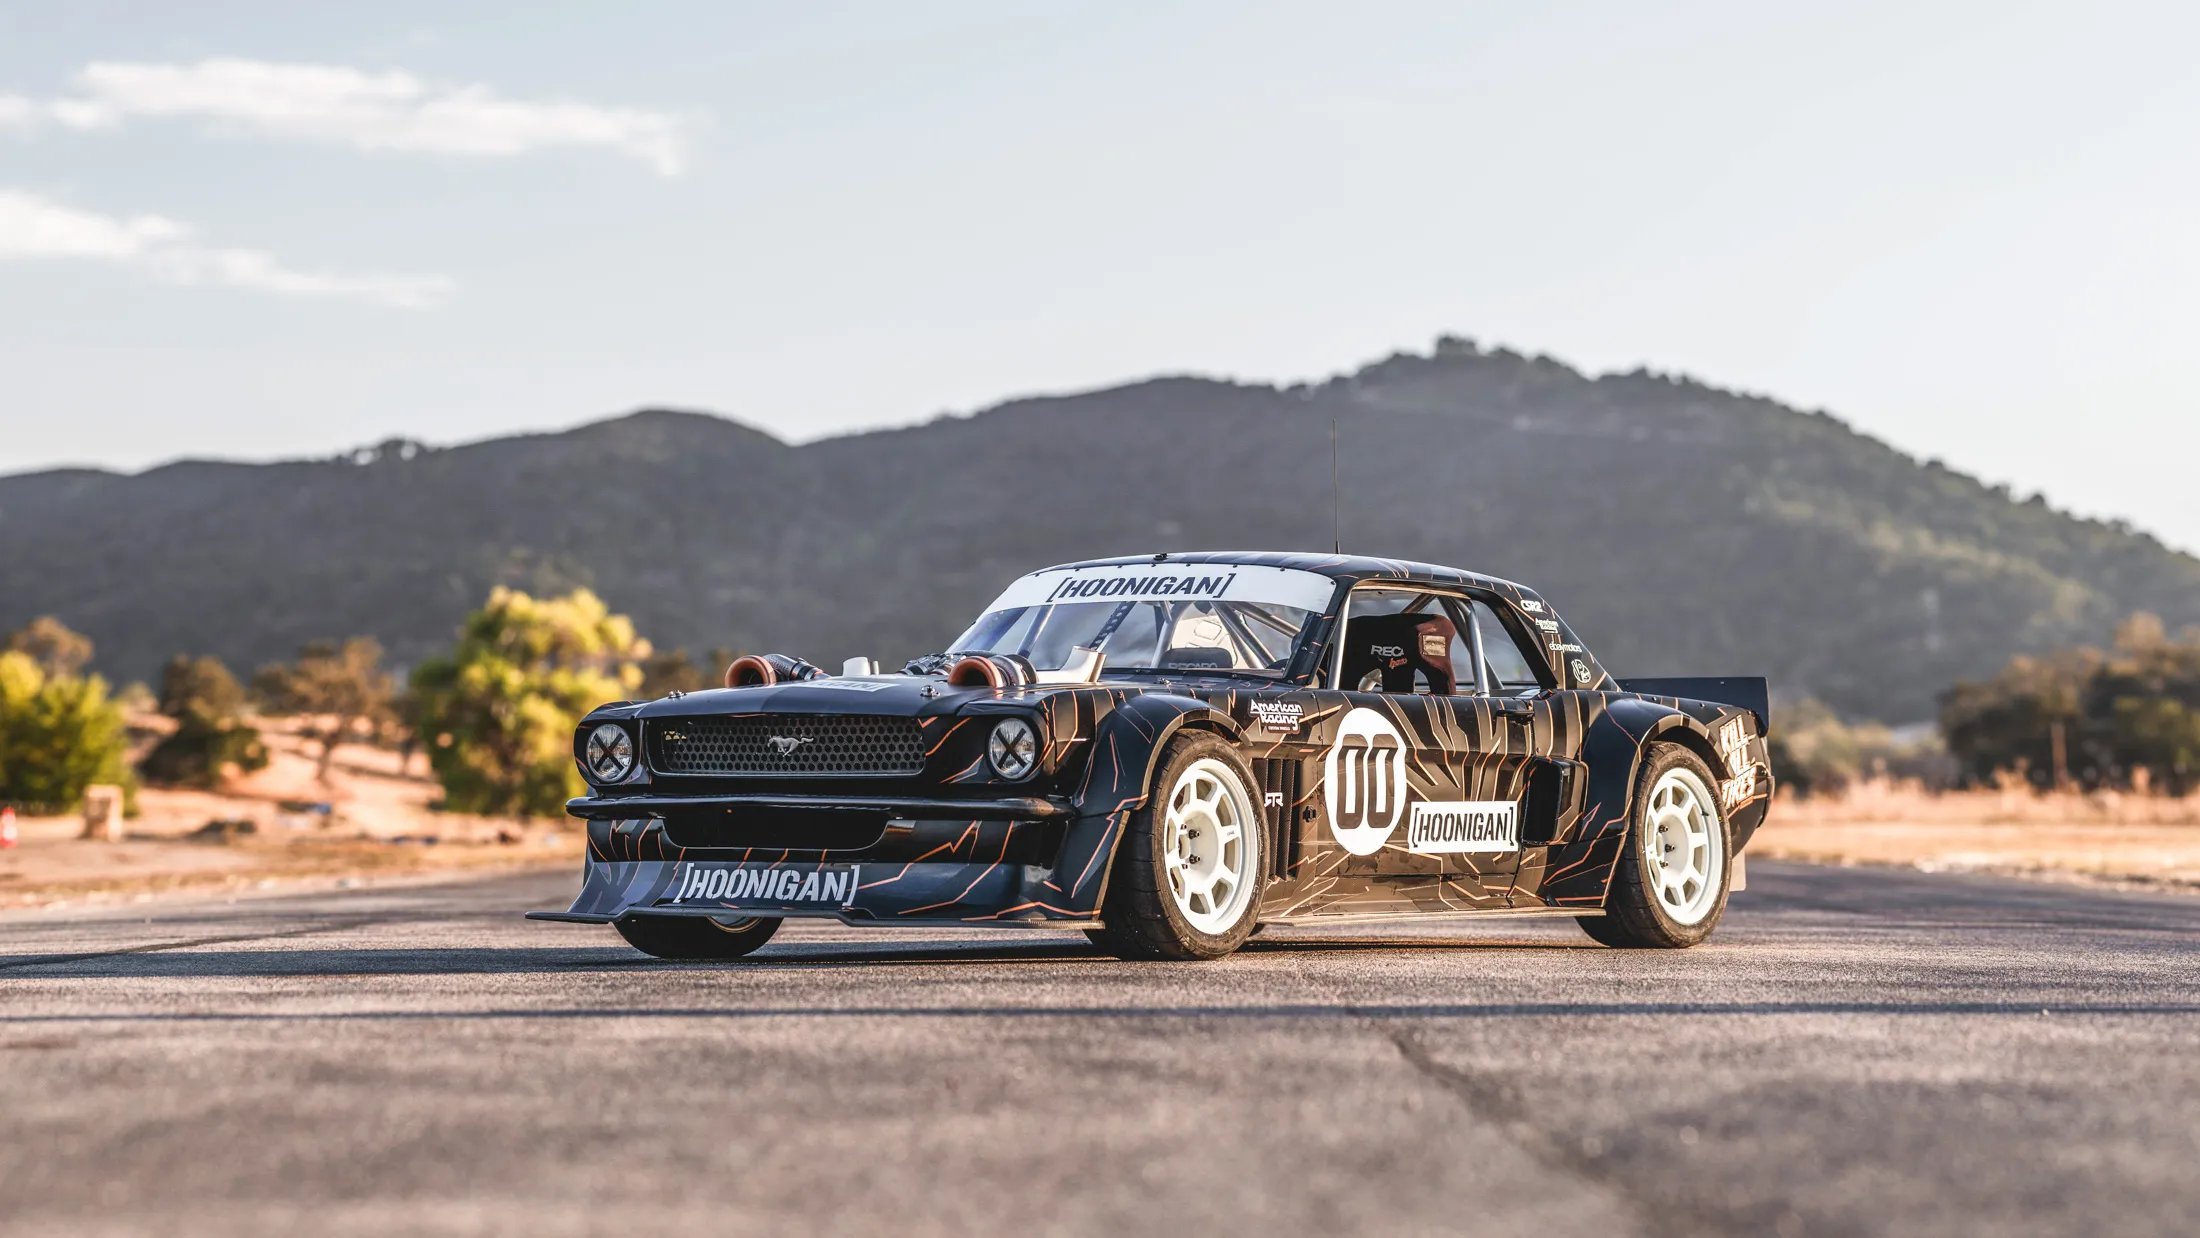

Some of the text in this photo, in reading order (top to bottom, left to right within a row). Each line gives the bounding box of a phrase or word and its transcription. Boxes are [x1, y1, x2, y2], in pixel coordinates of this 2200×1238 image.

[1046, 573, 1236, 602] [HOONIGAN]
[1250, 699, 1303, 713] American
[1260, 712, 1299, 731] Racing
[1720, 715, 1749, 755] KILL
[1336, 733, 1399, 829] 00
[1721, 765, 1757, 809] TIRES
[1412, 806, 1515, 848] [HOONIGAN]
[673, 862, 861, 906] [HOONIGAN]
